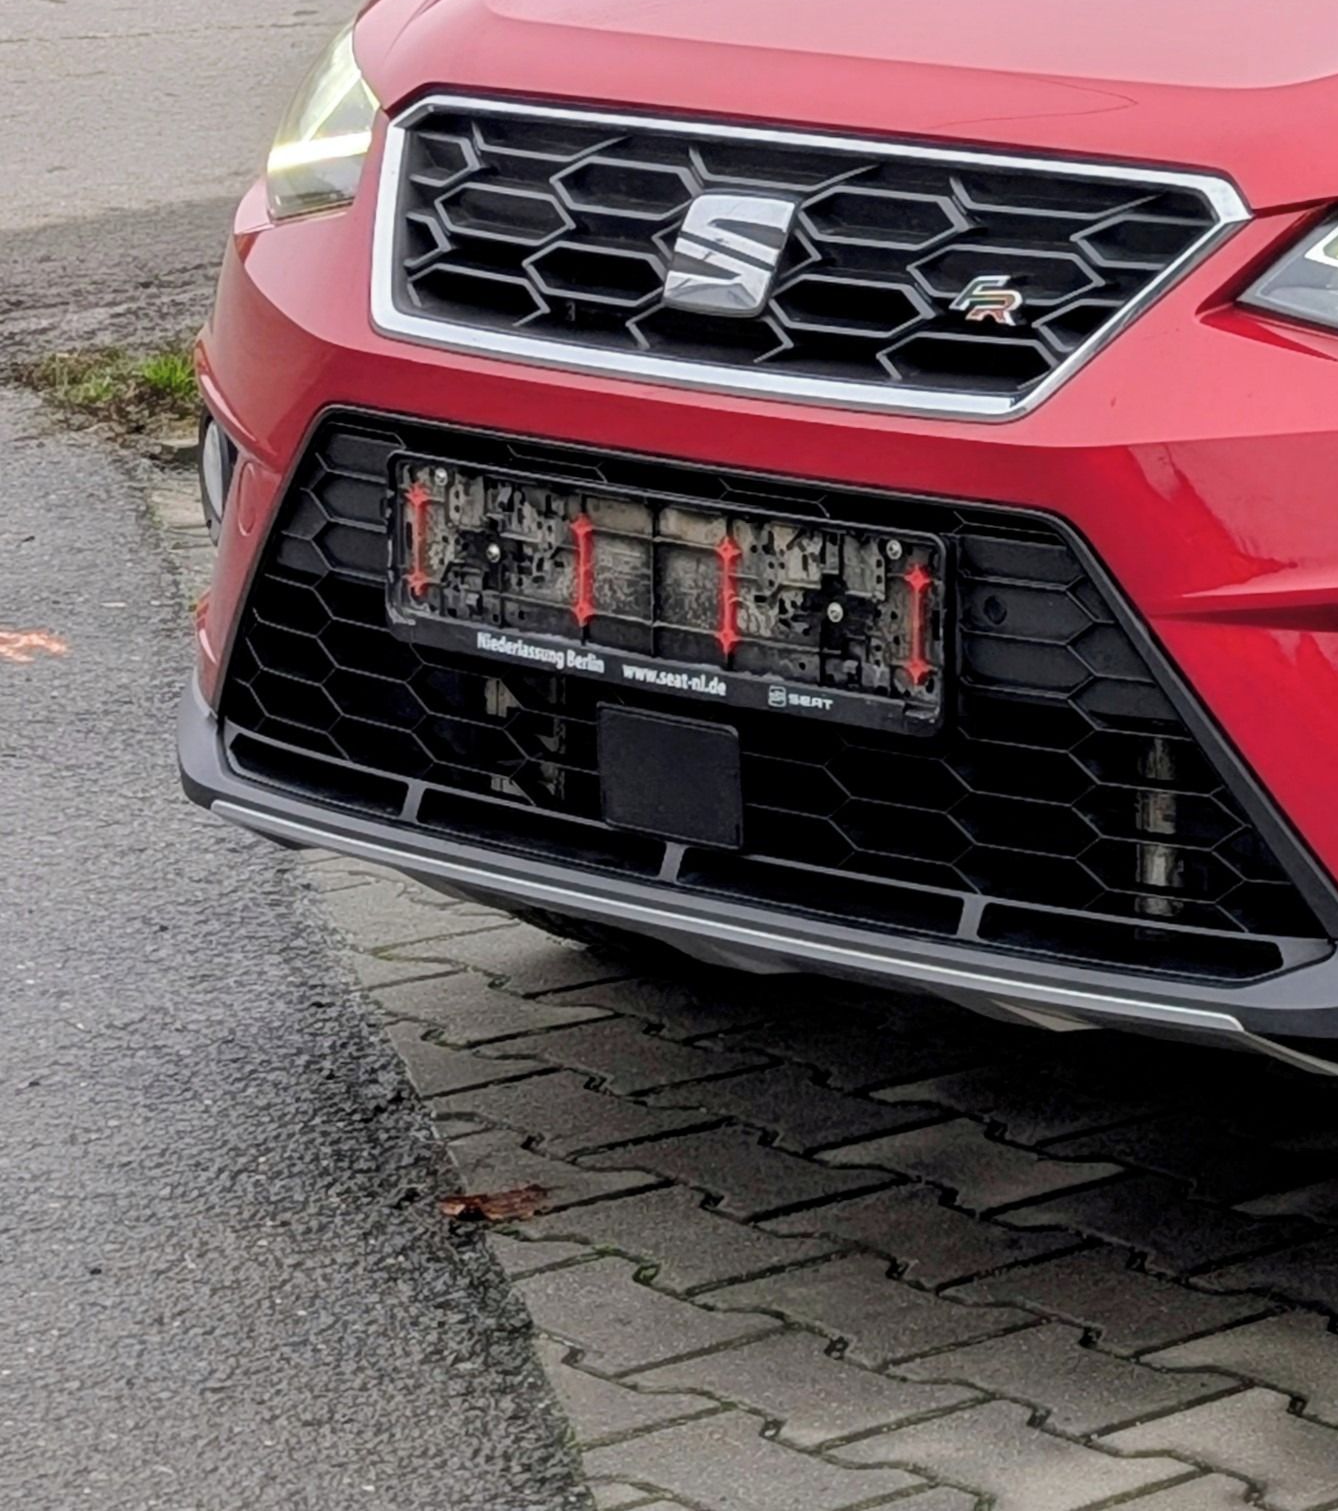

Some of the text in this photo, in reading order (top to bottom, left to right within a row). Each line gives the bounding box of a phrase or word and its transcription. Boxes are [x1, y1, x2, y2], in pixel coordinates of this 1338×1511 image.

[476, 631, 834, 710] Niederlassung Berlin www.seat-nl.de SEAT
